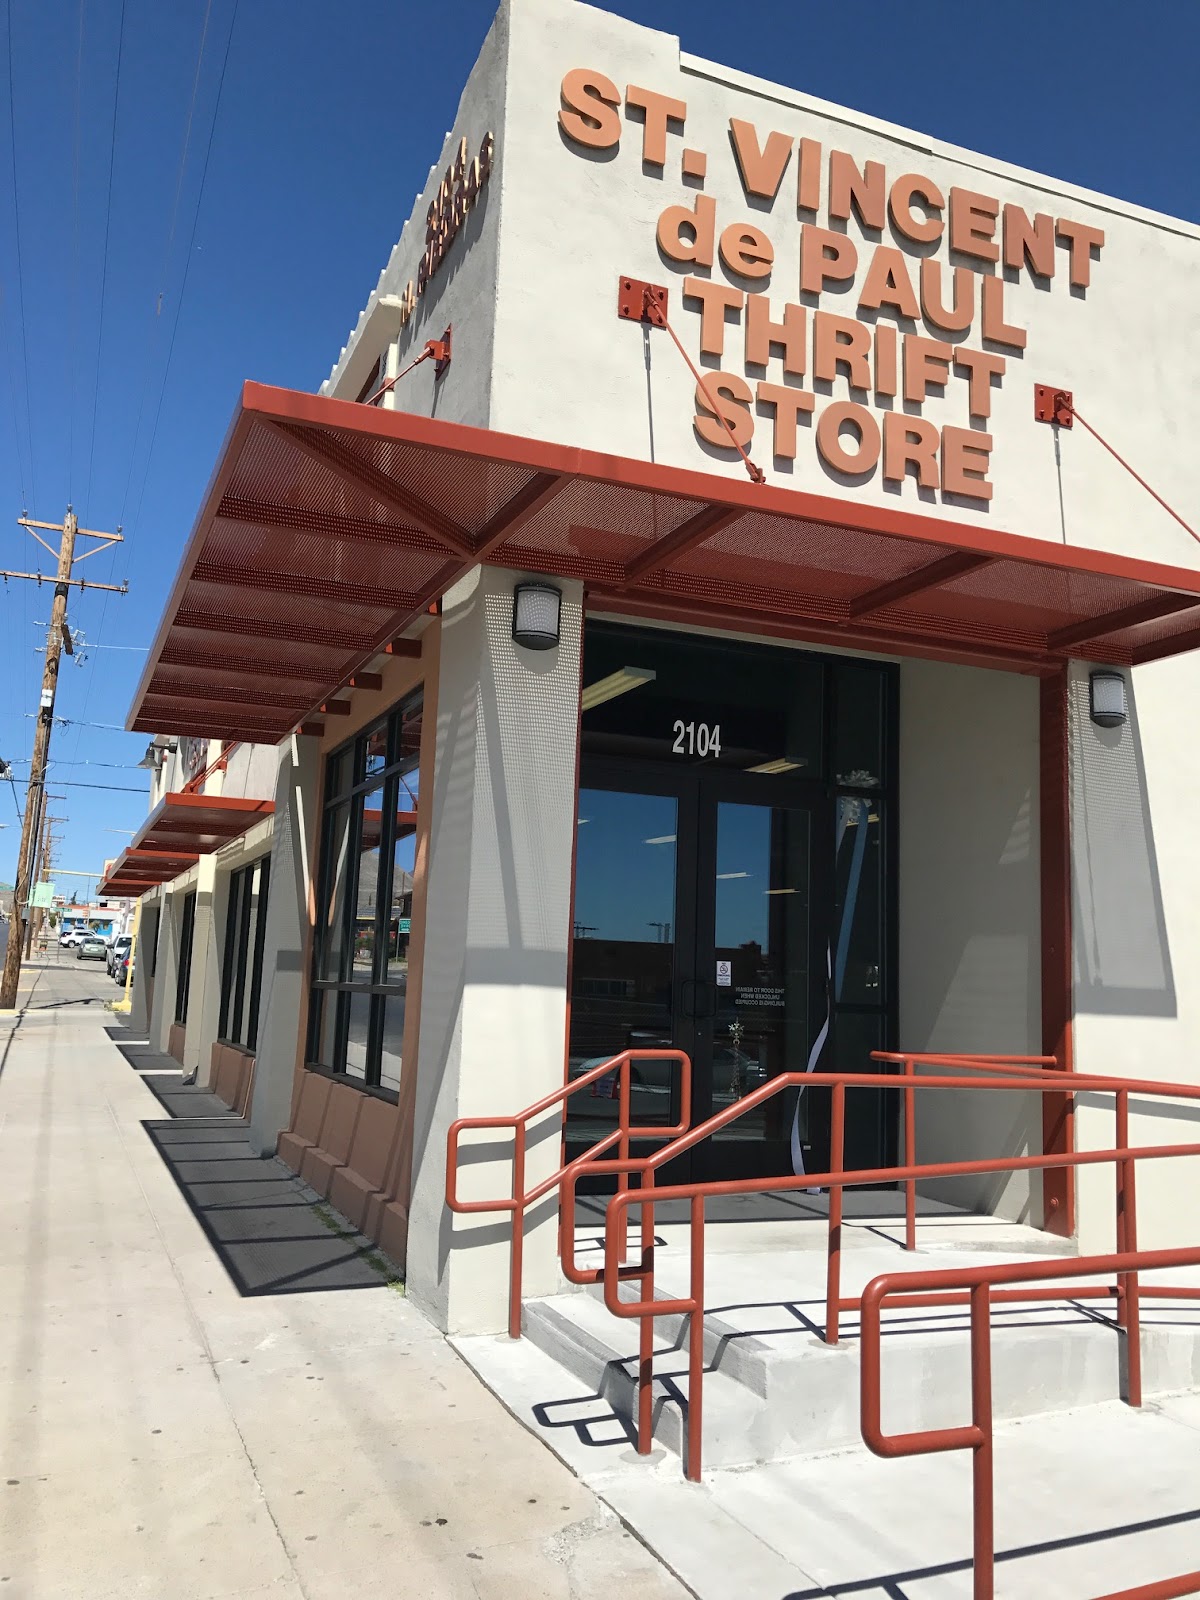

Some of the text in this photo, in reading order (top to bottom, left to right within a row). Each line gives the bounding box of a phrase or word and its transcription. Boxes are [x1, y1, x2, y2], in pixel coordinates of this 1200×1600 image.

[557, 68, 1105, 288] ST. VINCENT
[656, 194, 1027, 349] de PAUL
[683, 277, 1006, 418] THRIFT
[693, 371, 993, 500] STORE
[672, 719, 721, 758] 2104
